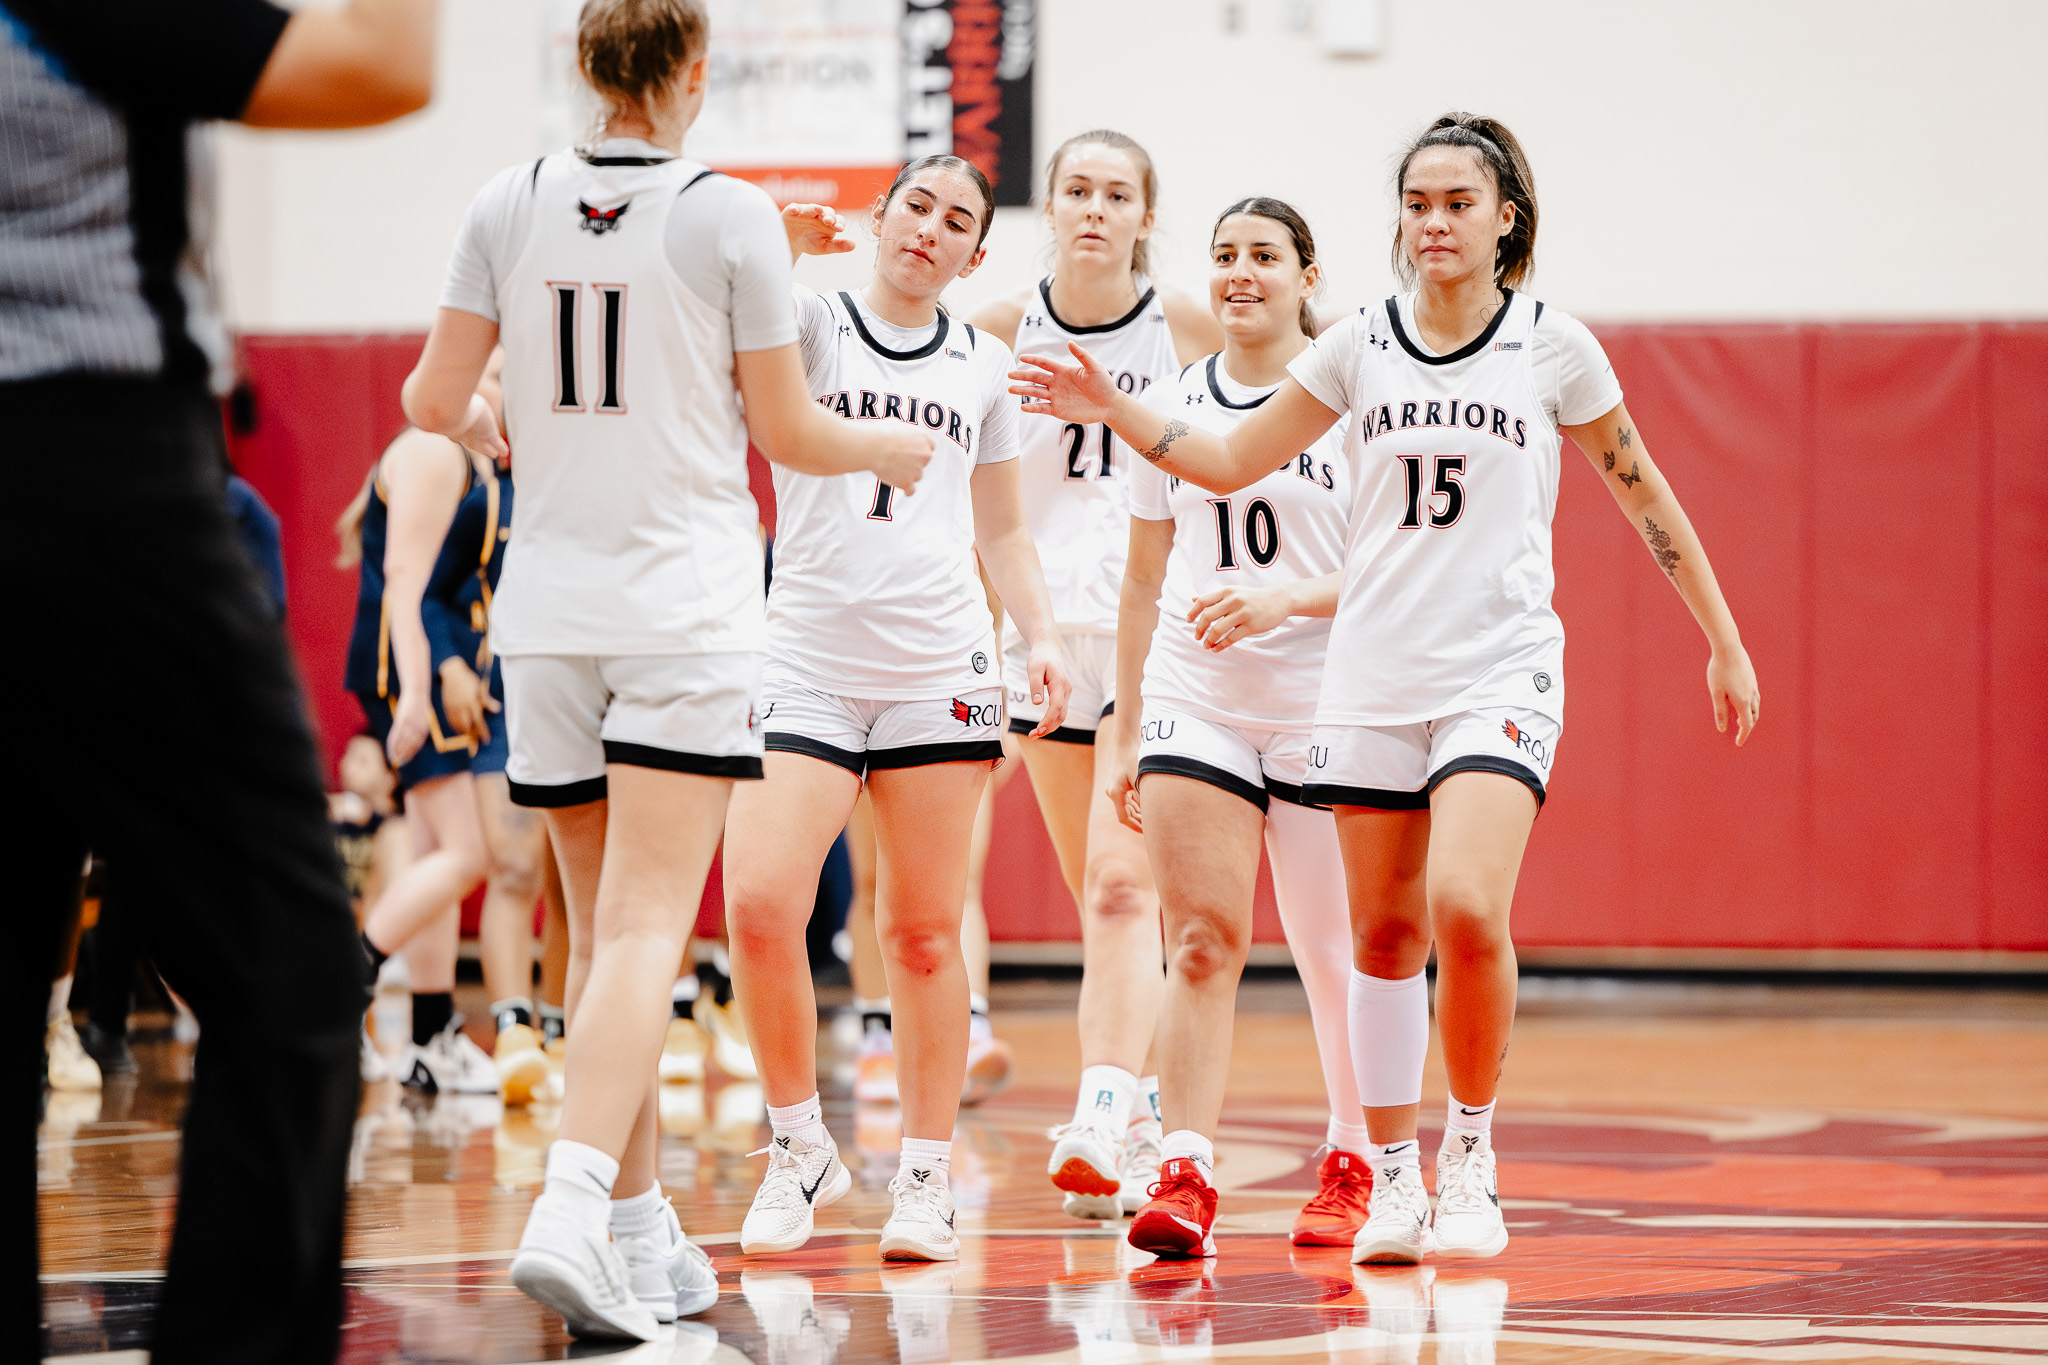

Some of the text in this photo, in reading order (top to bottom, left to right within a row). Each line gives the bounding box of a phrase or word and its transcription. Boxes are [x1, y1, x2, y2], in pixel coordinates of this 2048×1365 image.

[545, 280, 628, 415] 11
[1058, 422, 1117, 482] 21
[1362, 399, 1527, 450] WARRIORS
[1395, 455, 1467, 530] 15
[1205, 496, 1281, 572] 10
[965, 704, 1002, 727] RCU
[1516, 729, 1551, 770] RCU
